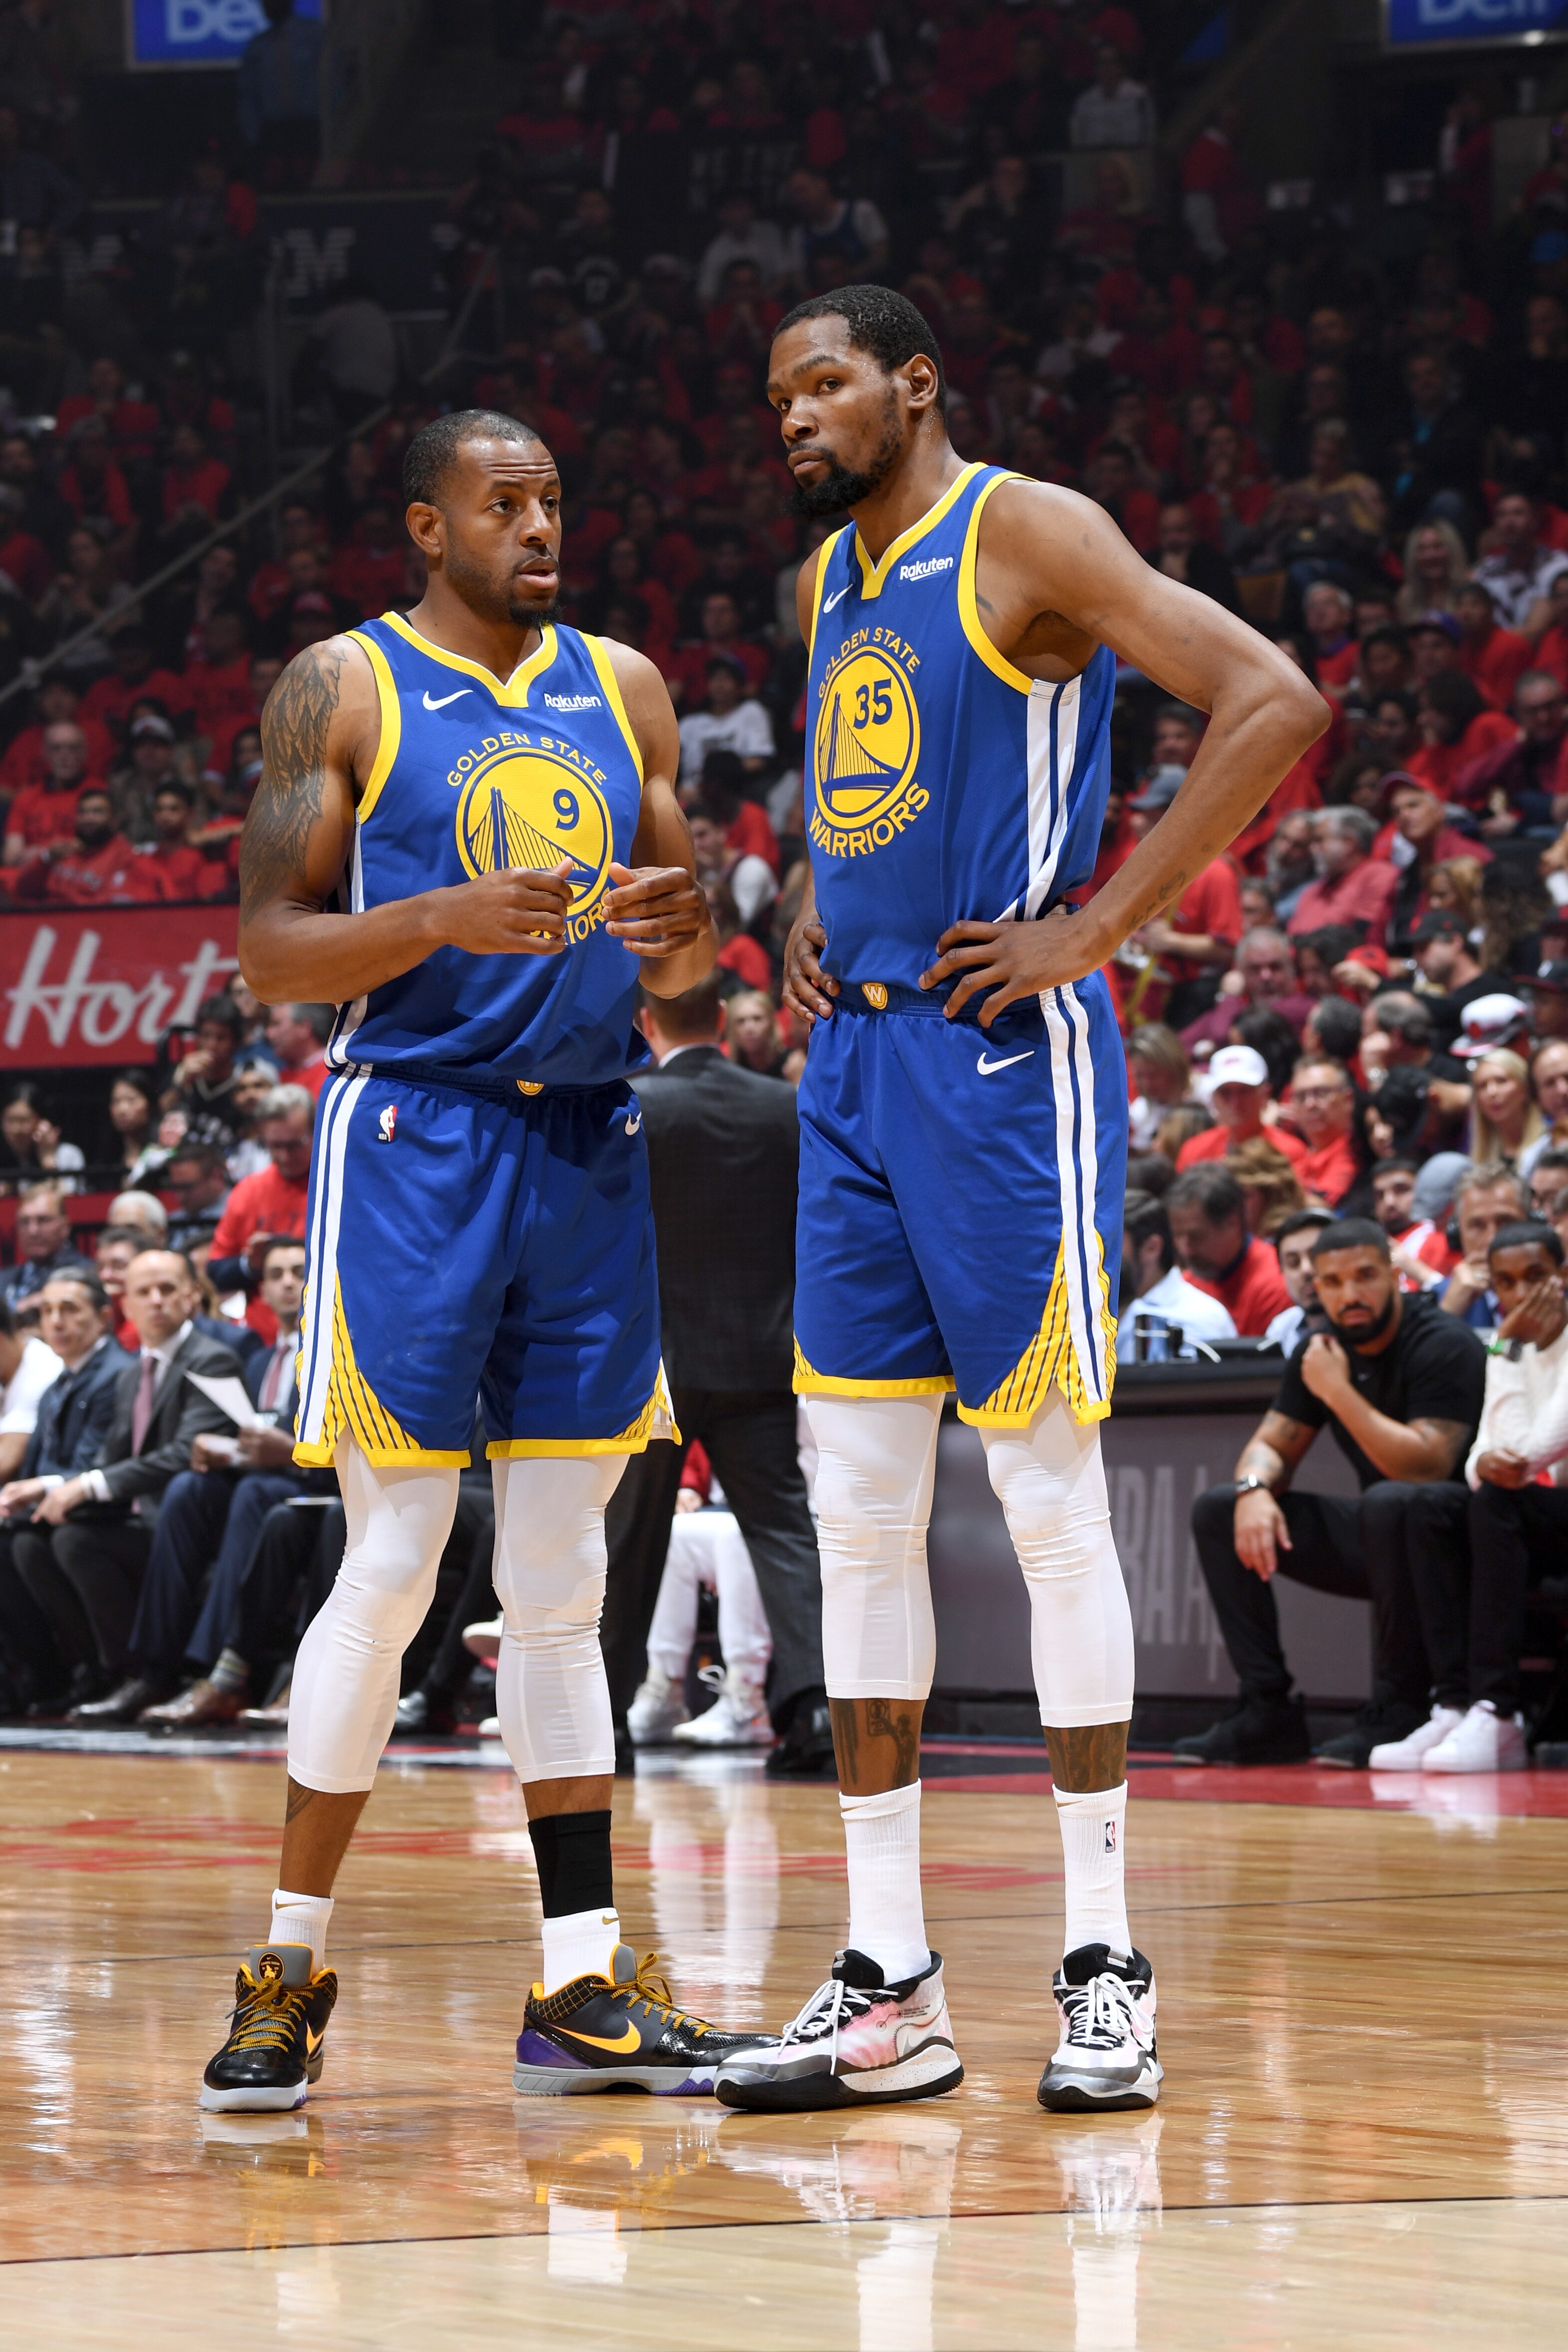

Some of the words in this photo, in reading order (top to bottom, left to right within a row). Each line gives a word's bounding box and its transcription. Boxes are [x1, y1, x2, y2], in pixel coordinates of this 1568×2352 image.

[165, 0, 269, 43] Be
[900, 557, 954, 581] Rakuten
[818, 627, 869, 698] GOLDEN
[872, 627, 921, 674] STATE
[544, 693, 602, 708] Rakuten
[853, 677, 893, 730] 35
[447, 732, 531, 786] GOLDEN
[540, 737, 607, 785] STATE
[553, 789, 580, 830] 9
[809, 782, 930, 858] WARRIORS
[4, 924, 239, 1049] Hort
[863, 984, 883, 1002] W
